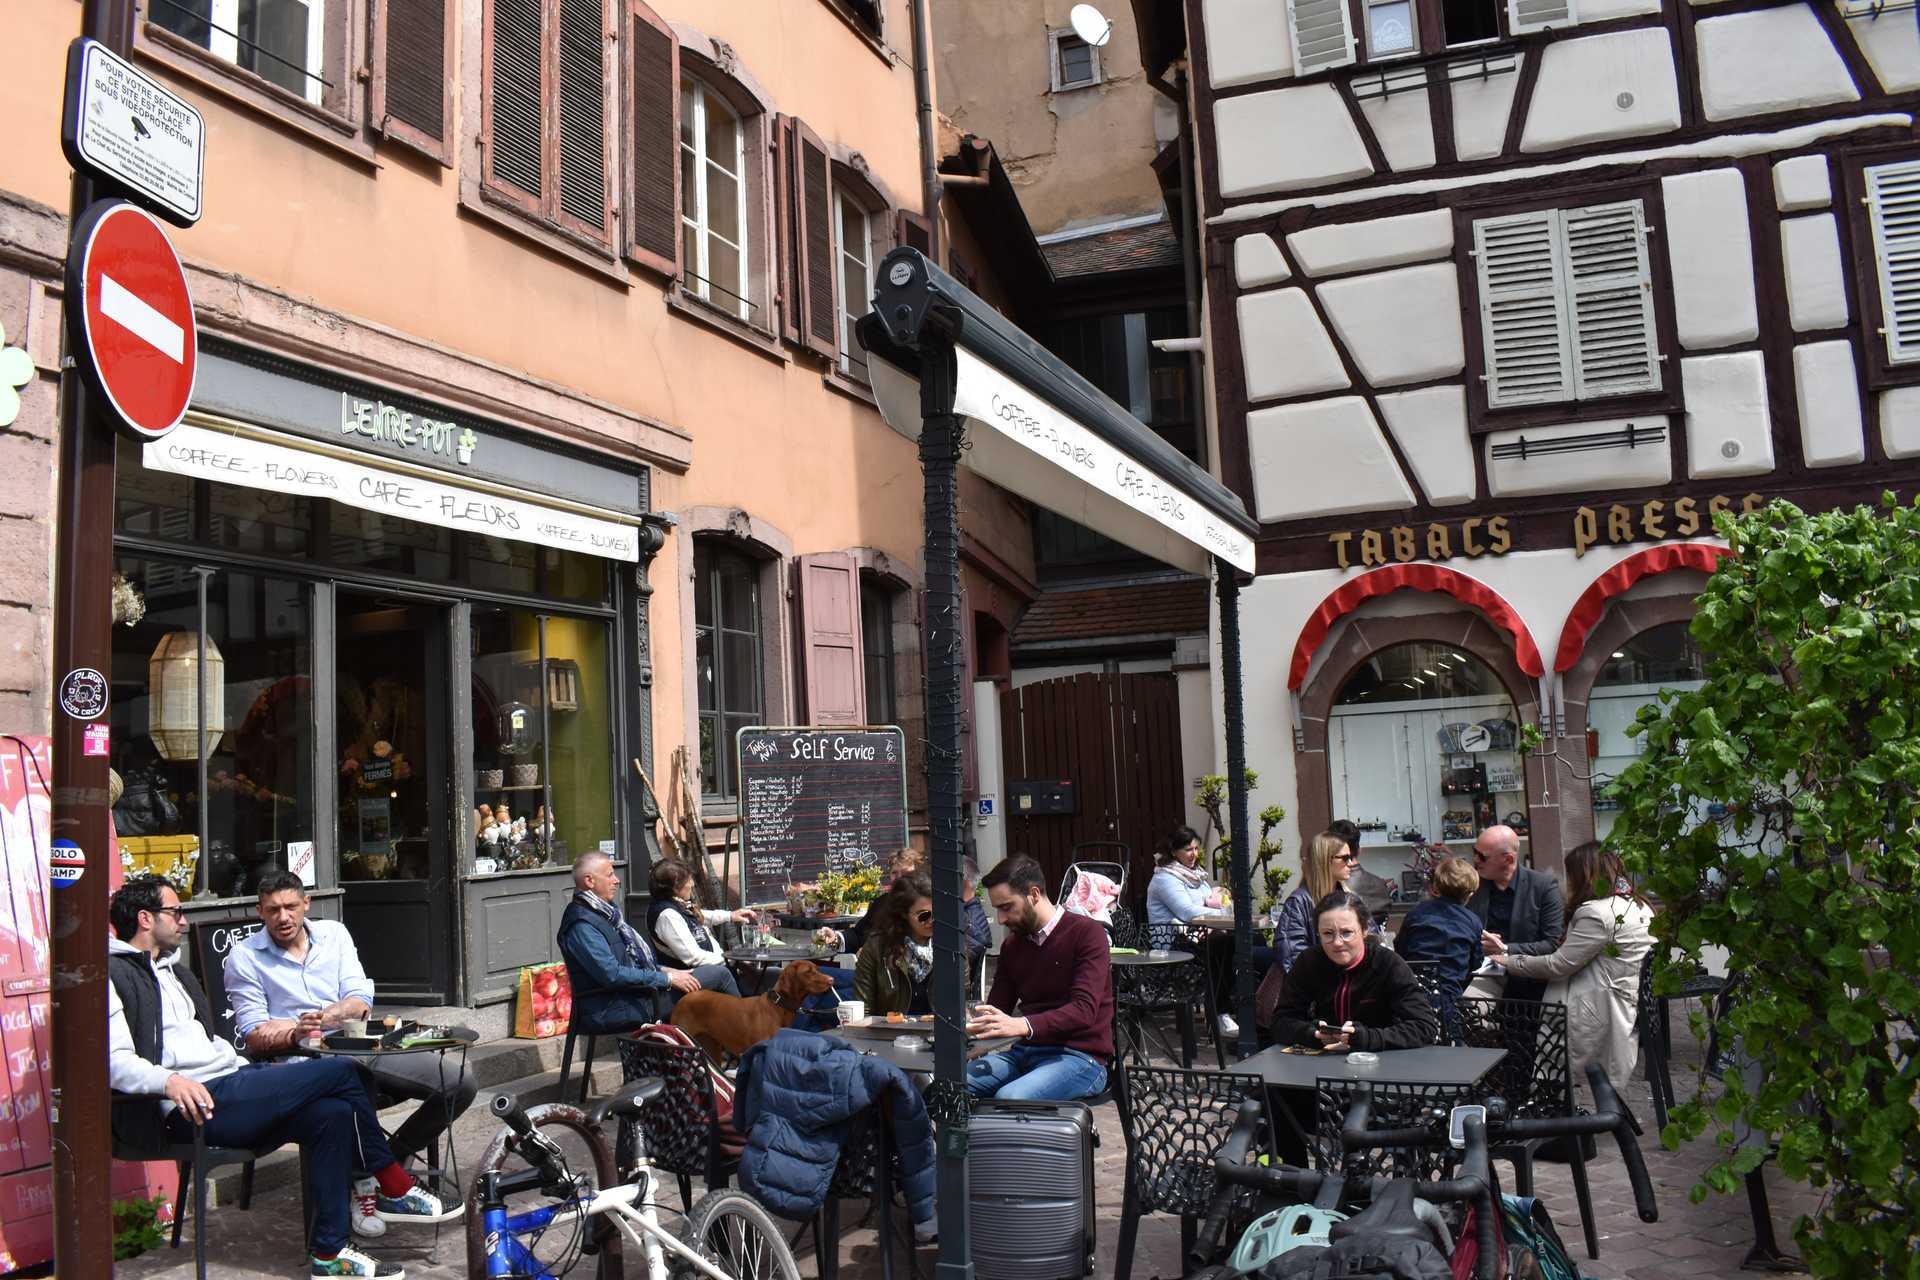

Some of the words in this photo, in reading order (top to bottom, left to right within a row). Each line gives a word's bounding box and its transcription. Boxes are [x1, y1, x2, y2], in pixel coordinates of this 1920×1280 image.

[95, 79, 118, 101] SOUS
[100, 58, 124, 80] POUR
[126, 76, 152, 100] VOTRE
[108, 76, 120, 90] CE
[122, 84, 138, 101] SITE
[141, 98, 156, 113] EST
[342, 391, 456, 456] L'ENTRE-POT
[992, 394, 1041, 438] COFFEE
[1050, 428, 1096, 469] FLOWERS
[1116, 462, 1144, 497] CAFE
[168, 445, 250, 473] COFFEE
[264, 462, 338, 490] FLOWERS
[359, 478, 422, 509] CAFE
[440, 495, 520, 530] FLEURS
[536, 522, 583, 542] KAFFEE
[590, 532, 630, 552] BLUMEN
[1328, 515, 1512, 572] TABACS
[833, 736, 875, 761] Service
